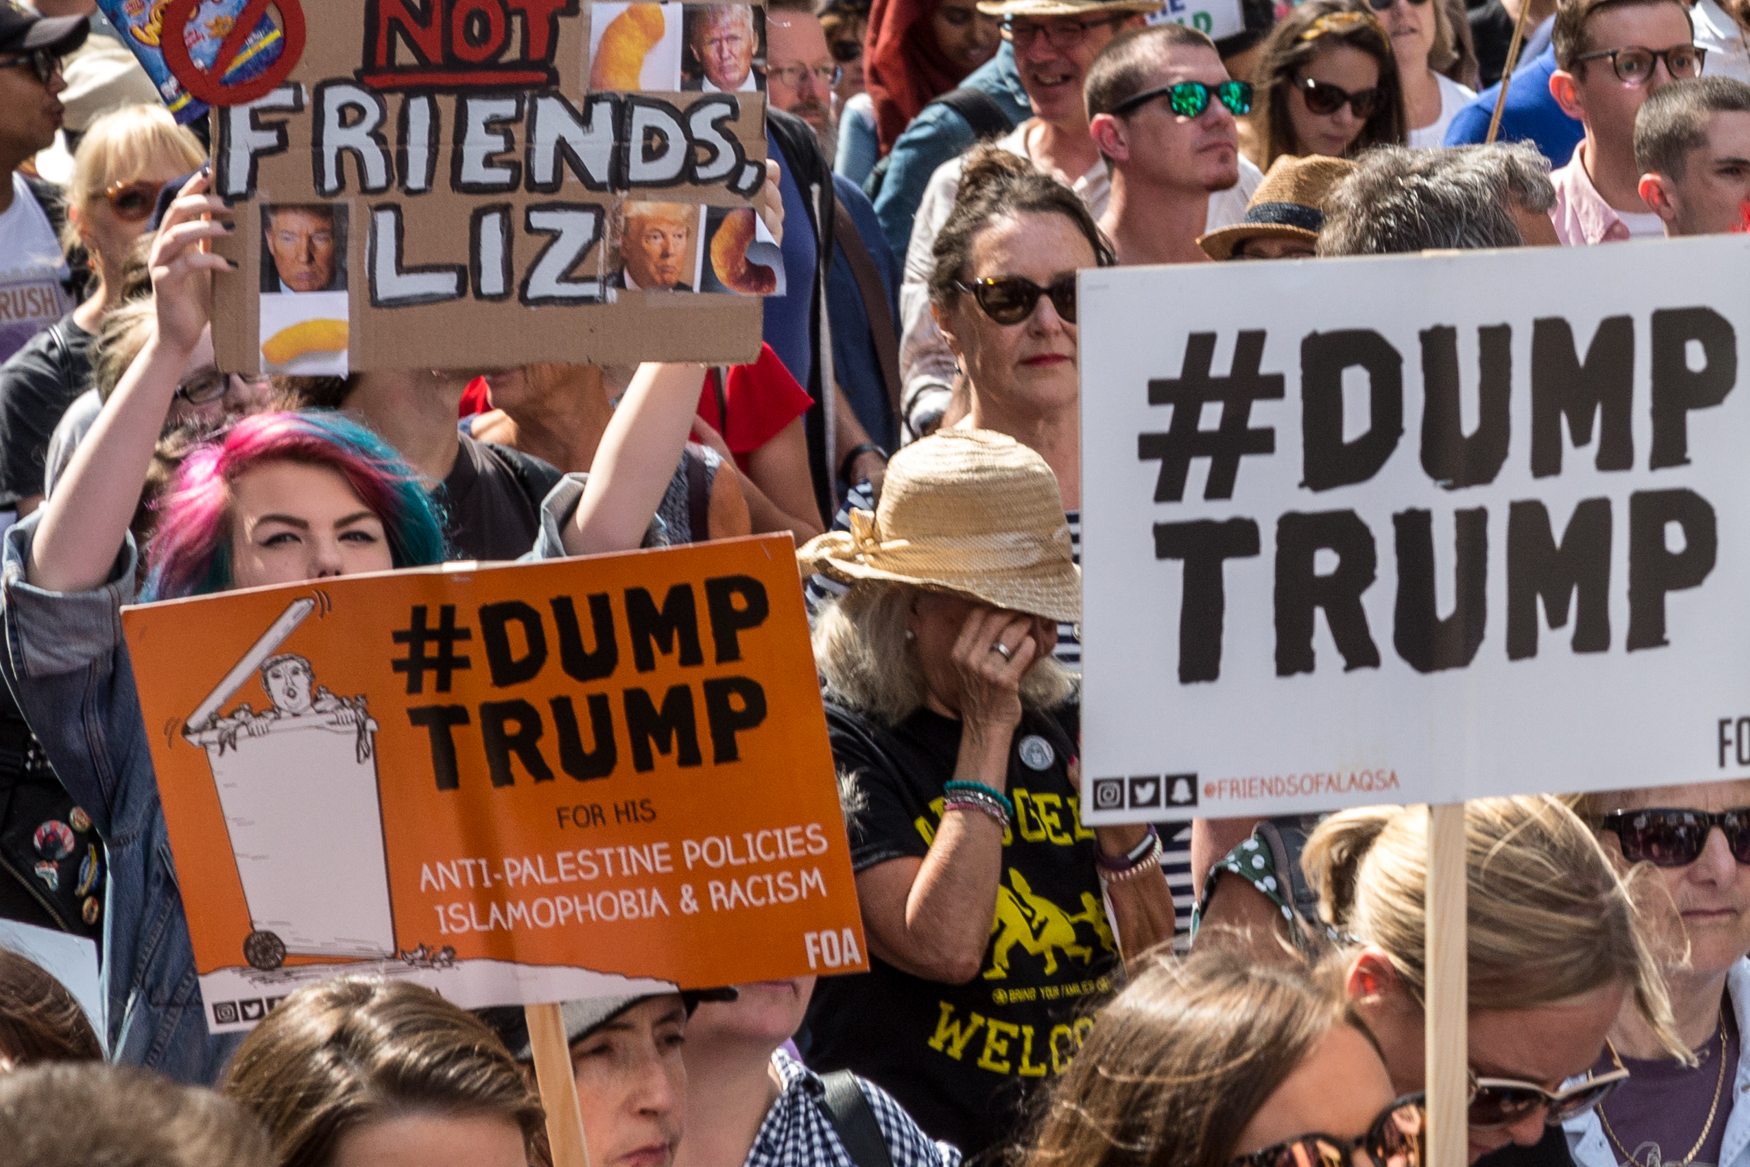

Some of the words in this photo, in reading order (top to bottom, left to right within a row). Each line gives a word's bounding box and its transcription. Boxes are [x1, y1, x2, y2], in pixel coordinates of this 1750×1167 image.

[216, 79, 767, 201] FRIENDS,
[366, 201, 615, 307] LIZ
[1137, 305, 1739, 503] #DUMP
[391, 575, 770, 695] #DUMP
[1152, 488, 1719, 685] TRUMP
[406, 676, 768, 790] TRUMP
[1203, 769, 1400, 801] @FRIENDSOFALAQSA
[420, 841, 674, 893] ANTI-PALESTINE
[681, 823, 830, 871] POLICIES
[556, 803, 605, 831] FOR
[614, 798, 656, 825] HIS
[434, 887, 668, 934] ISLAMOPHOBIA
[680, 885, 699, 914] &
[707, 868, 826, 909] RACISM
[805, 929, 861, 970] FOA
